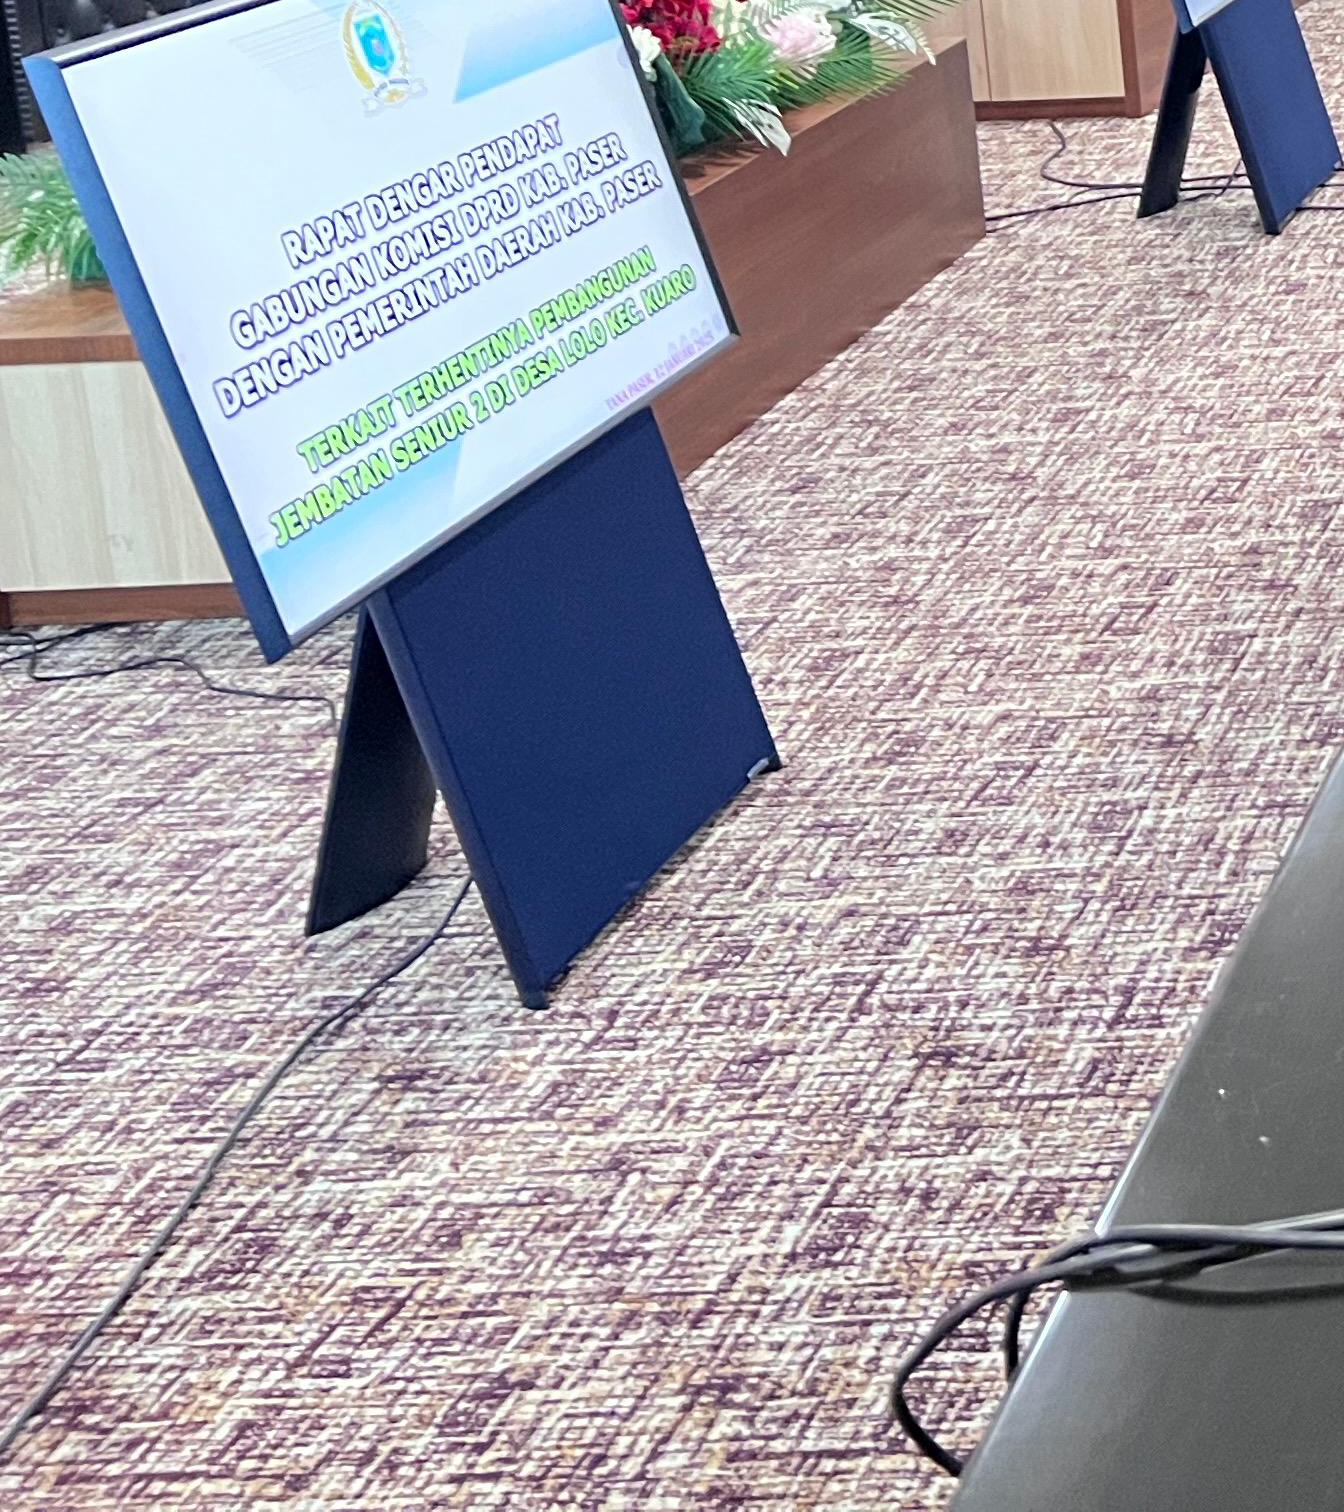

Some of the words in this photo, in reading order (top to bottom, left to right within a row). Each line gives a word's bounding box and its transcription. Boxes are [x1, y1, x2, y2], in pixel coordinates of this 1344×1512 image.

[213, 330, 330, 418] DENGAN
[326, 253, 480, 358] PEMERINTAH
[475, 211, 562, 280] DAERAH
[557, 192, 606, 236] KAB.
[600, 160, 663, 213] PASER
[230, 253, 376, 349] GABUNGAN
[371, 210, 463, 280] KOMISI
[459, 184, 520, 237] DPRD
[517, 164, 568, 208] KAB.
[564, 132, 628, 185] PASER
[281, 202, 365, 269] RAPAT
[364, 161, 463, 230] DENGAR
[458, 113, 563, 187] PENDAPAT
[268, 448, 394, 547] JEMBATAN
[390, 402, 474, 473] SENIUR
[468, 390, 490, 424] 2
[484, 374, 516, 413] DI
[511, 347, 565, 397] DESA
[559, 318, 607, 367] LOLO
[604, 297, 645, 338] KEC.
[641, 264, 696, 316] KUARO
[296, 394, 397, 473] TERKAIT
[392, 318, 534, 417] TERHENTINYA
[529, 245, 656, 338] PEMBANGUNAN
